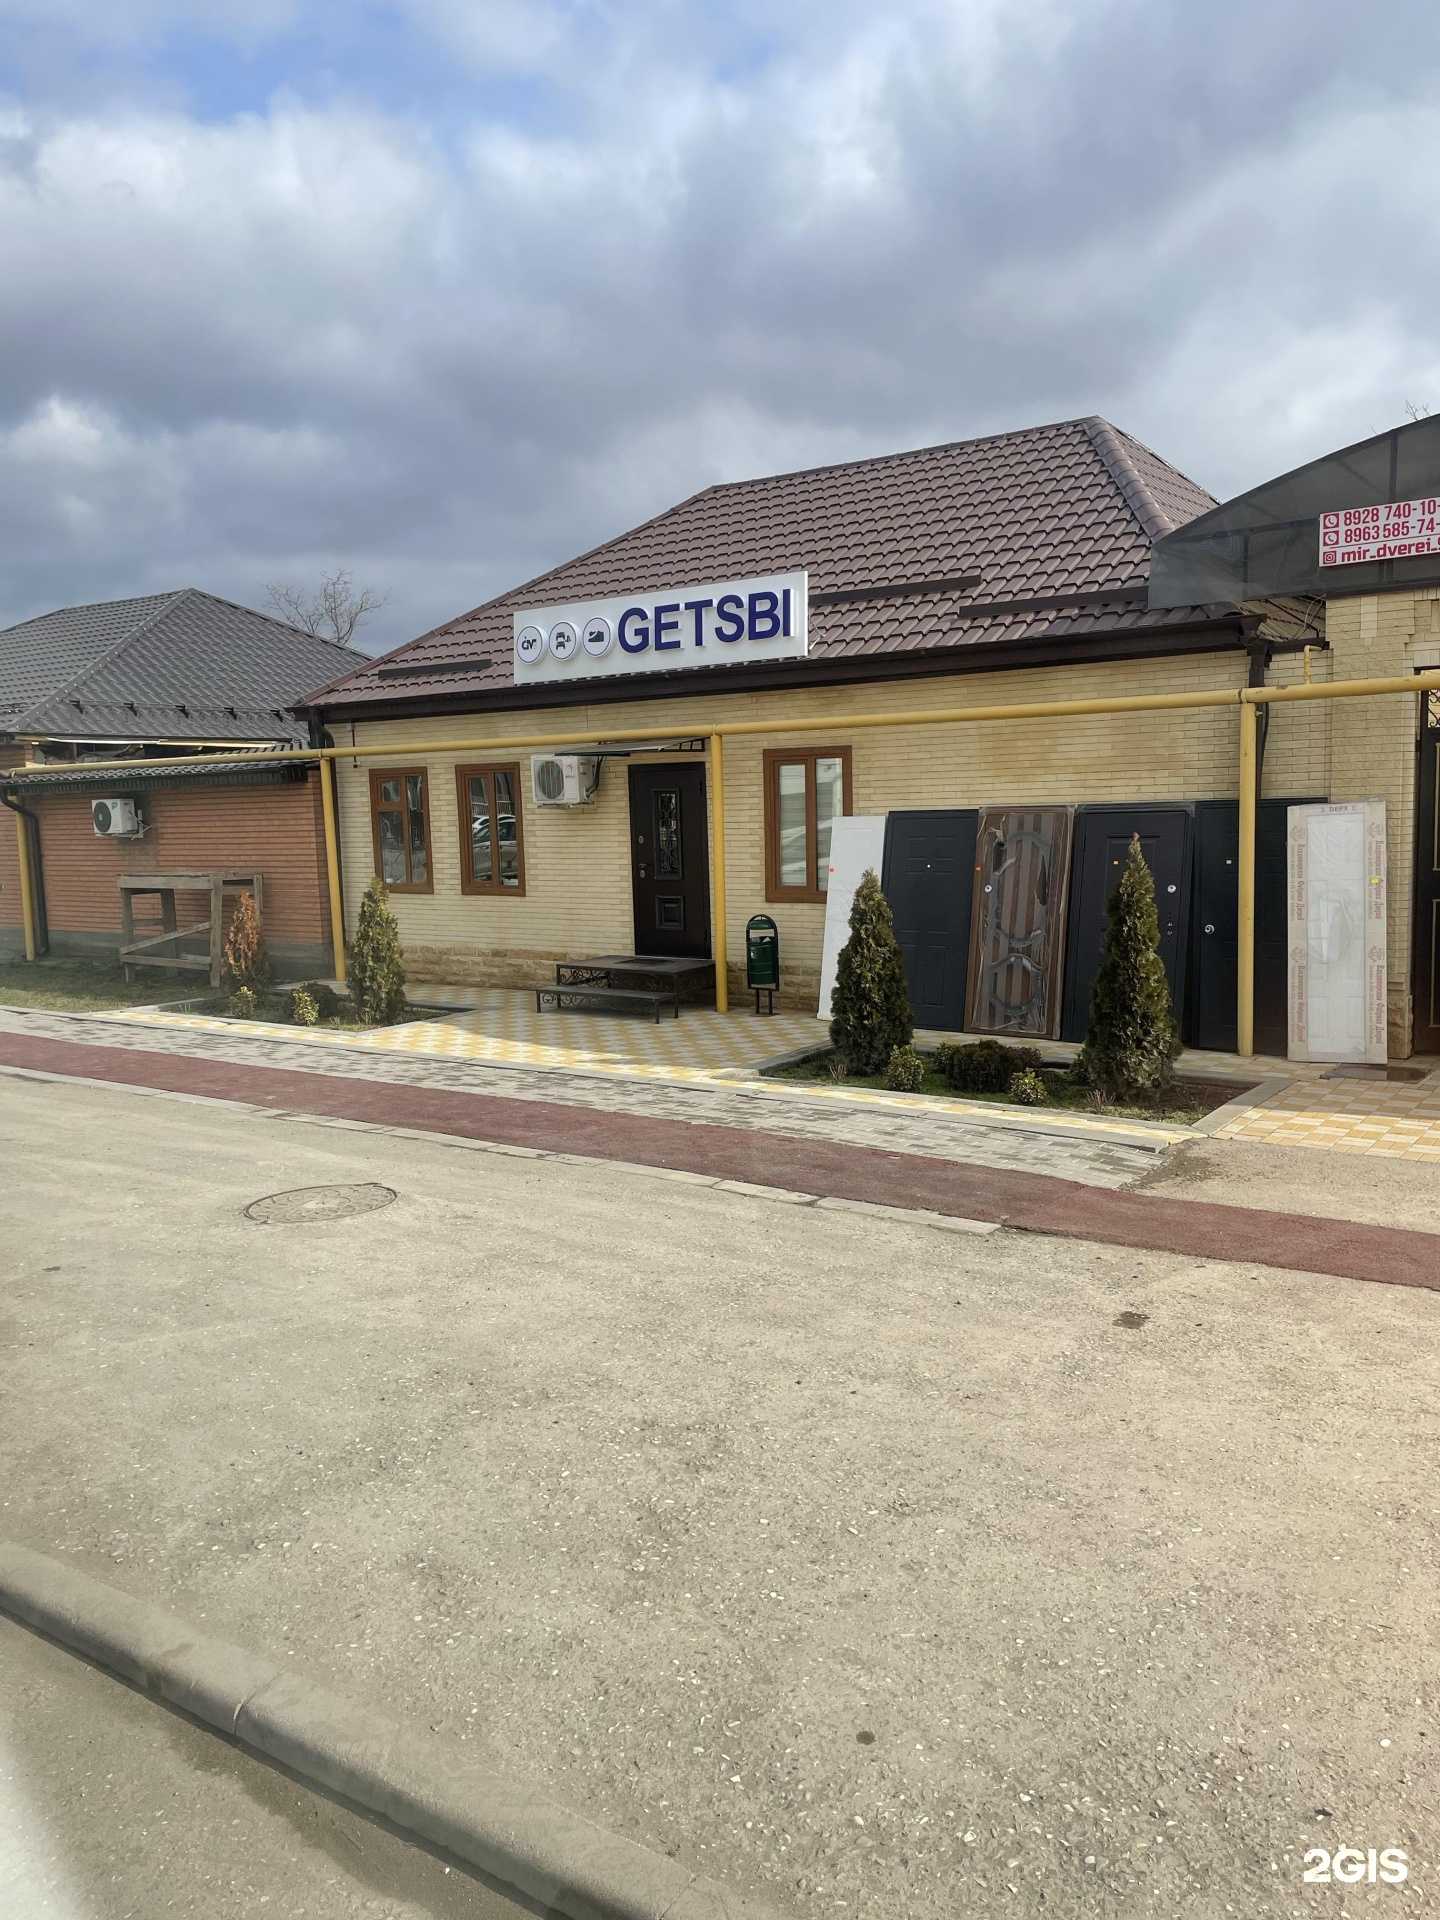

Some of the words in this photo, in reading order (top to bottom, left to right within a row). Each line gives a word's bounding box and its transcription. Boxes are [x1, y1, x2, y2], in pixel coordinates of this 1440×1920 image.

[1344, 507, 1379, 526] 8928
[1344, 525, 1380, 544] 8963
[1341, 536, 1440, 562] mir_dverei_
[618, 588, 792, 653] GETSBI
